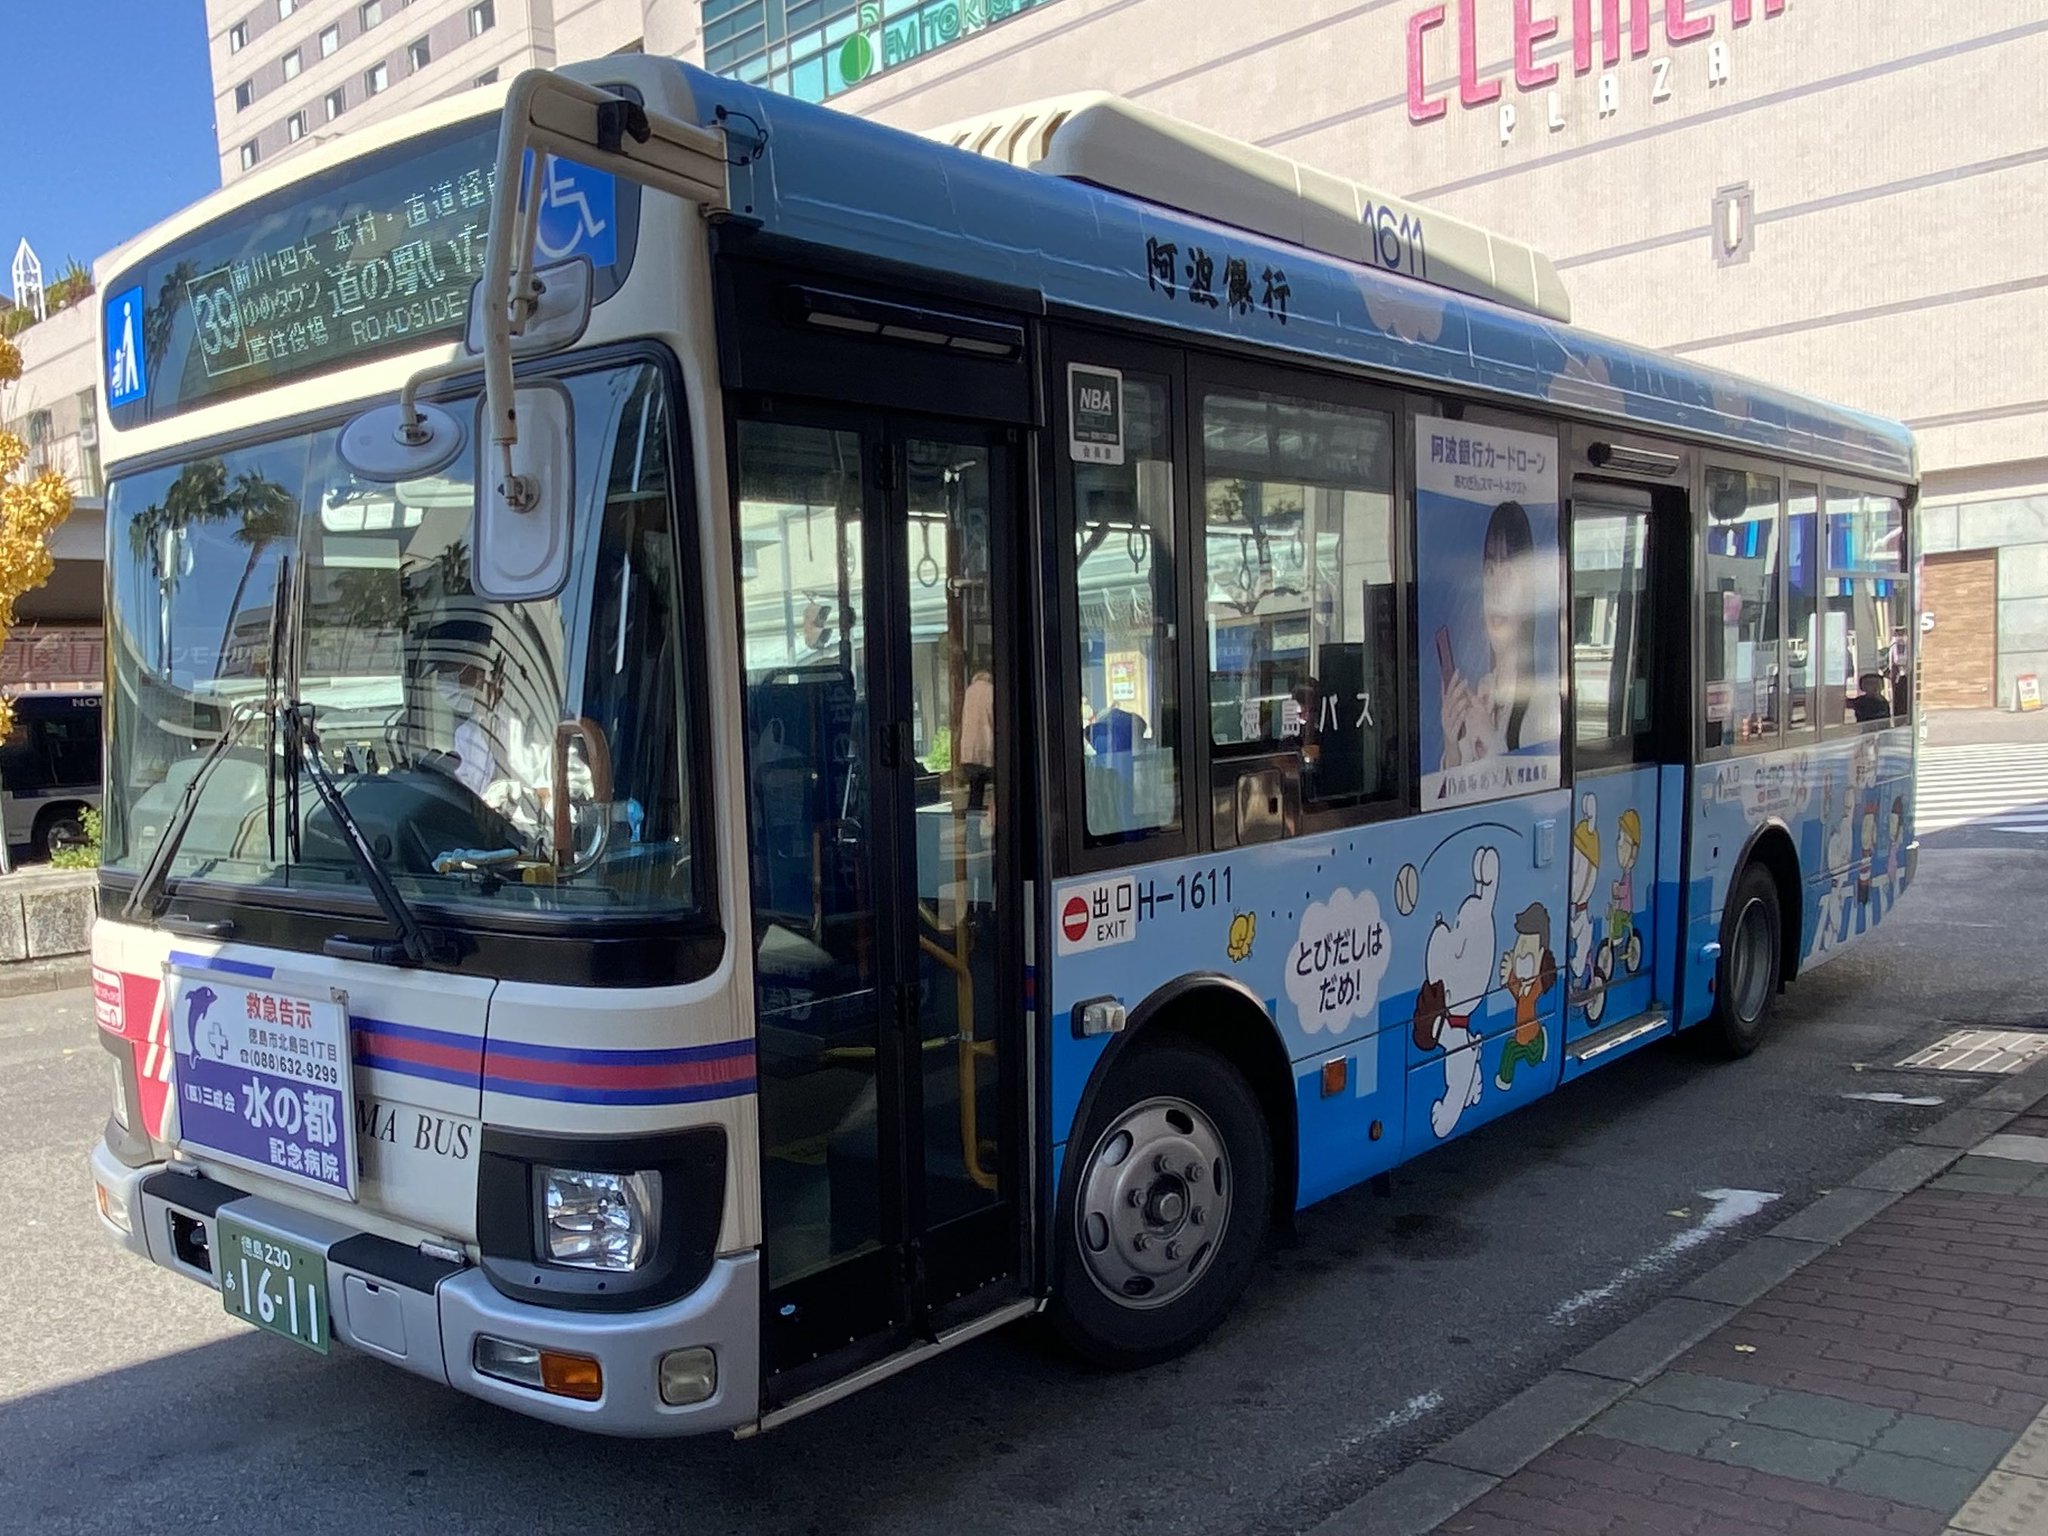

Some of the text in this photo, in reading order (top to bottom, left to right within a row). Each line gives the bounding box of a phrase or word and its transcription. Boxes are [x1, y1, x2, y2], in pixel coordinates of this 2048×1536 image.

[1500, 42, 1727, 146] PLAZA
[1363, 200, 1427, 278] 1611
[1146, 237, 1291, 325] 阿波銀行
[195, 287, 241, 355] 39
[1080, 387, 1112, 412] NBA
[1431, 434, 1546, 475] 阿波銀行カードローン
[1092, 883, 1132, 919] 出口
[1137, 866, 1232, 922] H-1611
[1097, 919, 1127, 942] EXIT
[1296, 922, 1384, 976] とびだしは
[246, 991, 312, 1029] 救急告示
[248, 1028, 337, 1062] 徳島市北島田1丁目
[242, 1076, 338, 1147] 水の都
[269, 1136, 340, 1182] 記念病院
[413, 1113, 472, 1160] BUS
[264, 1243, 292, 1271] 230
[225, 1258, 319, 1344] あ 16-11
